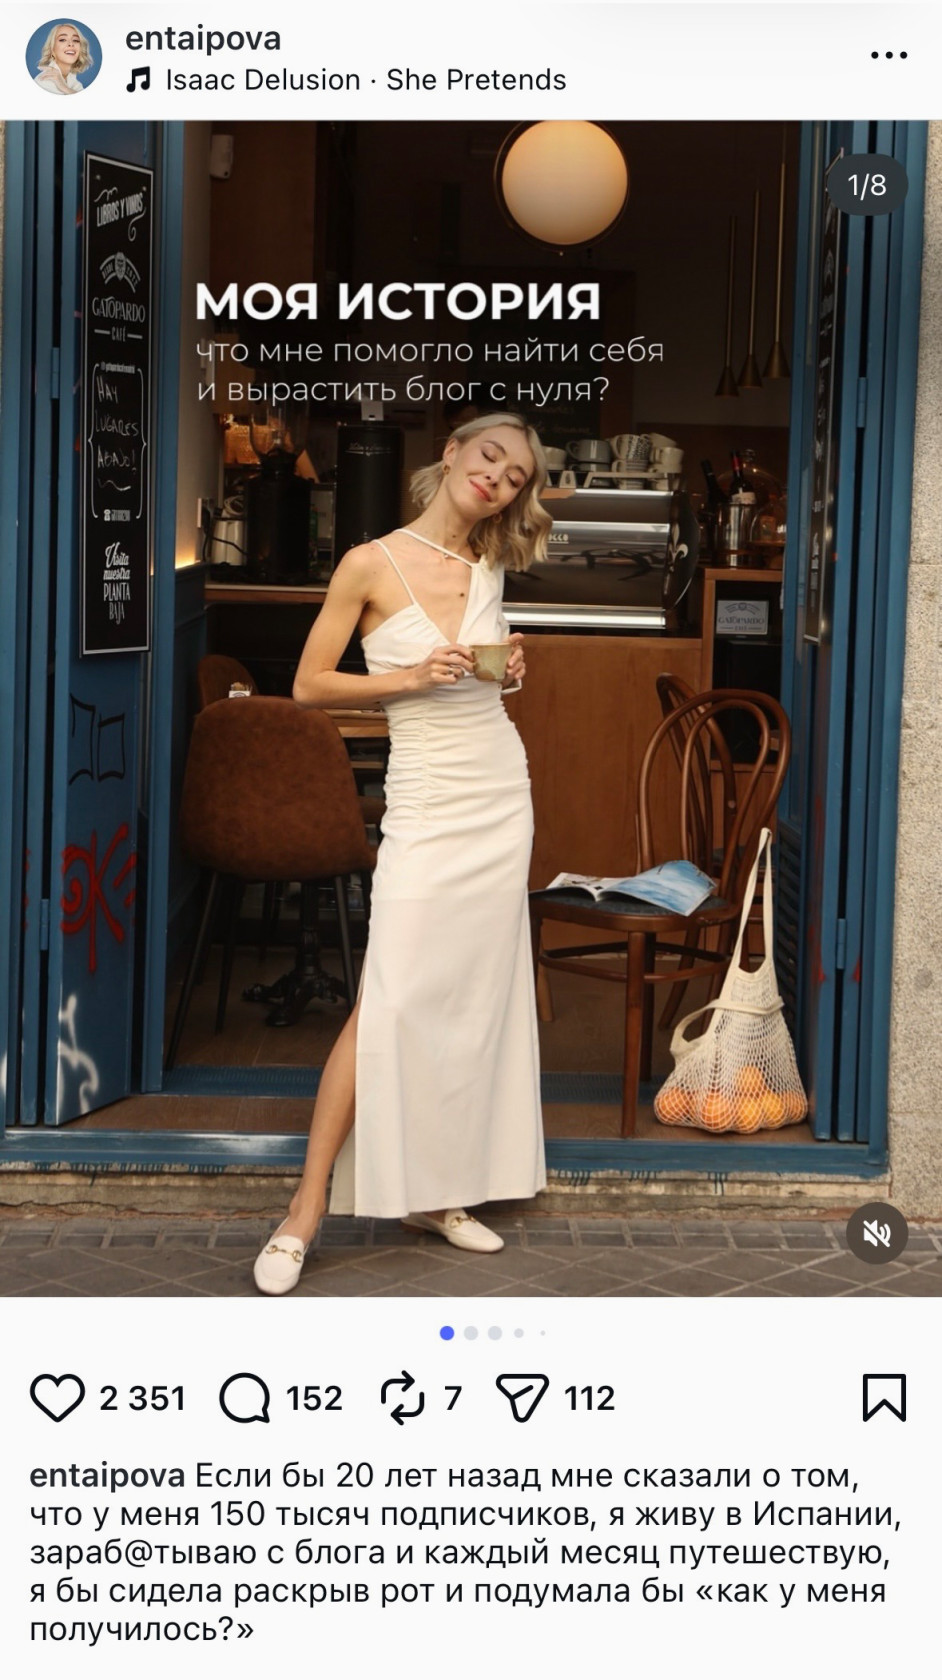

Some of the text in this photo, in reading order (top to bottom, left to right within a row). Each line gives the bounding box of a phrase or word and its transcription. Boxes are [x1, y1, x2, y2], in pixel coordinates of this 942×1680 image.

[119, 198, 125, 218] Y
[92, 296, 145, 323] GATOPARDO
[105, 542, 129, 568] Visita
[103, 567, 130, 580] nuestra
[103, 582, 130, 601] PLANTA
[109, 602, 125, 625] BAJA
